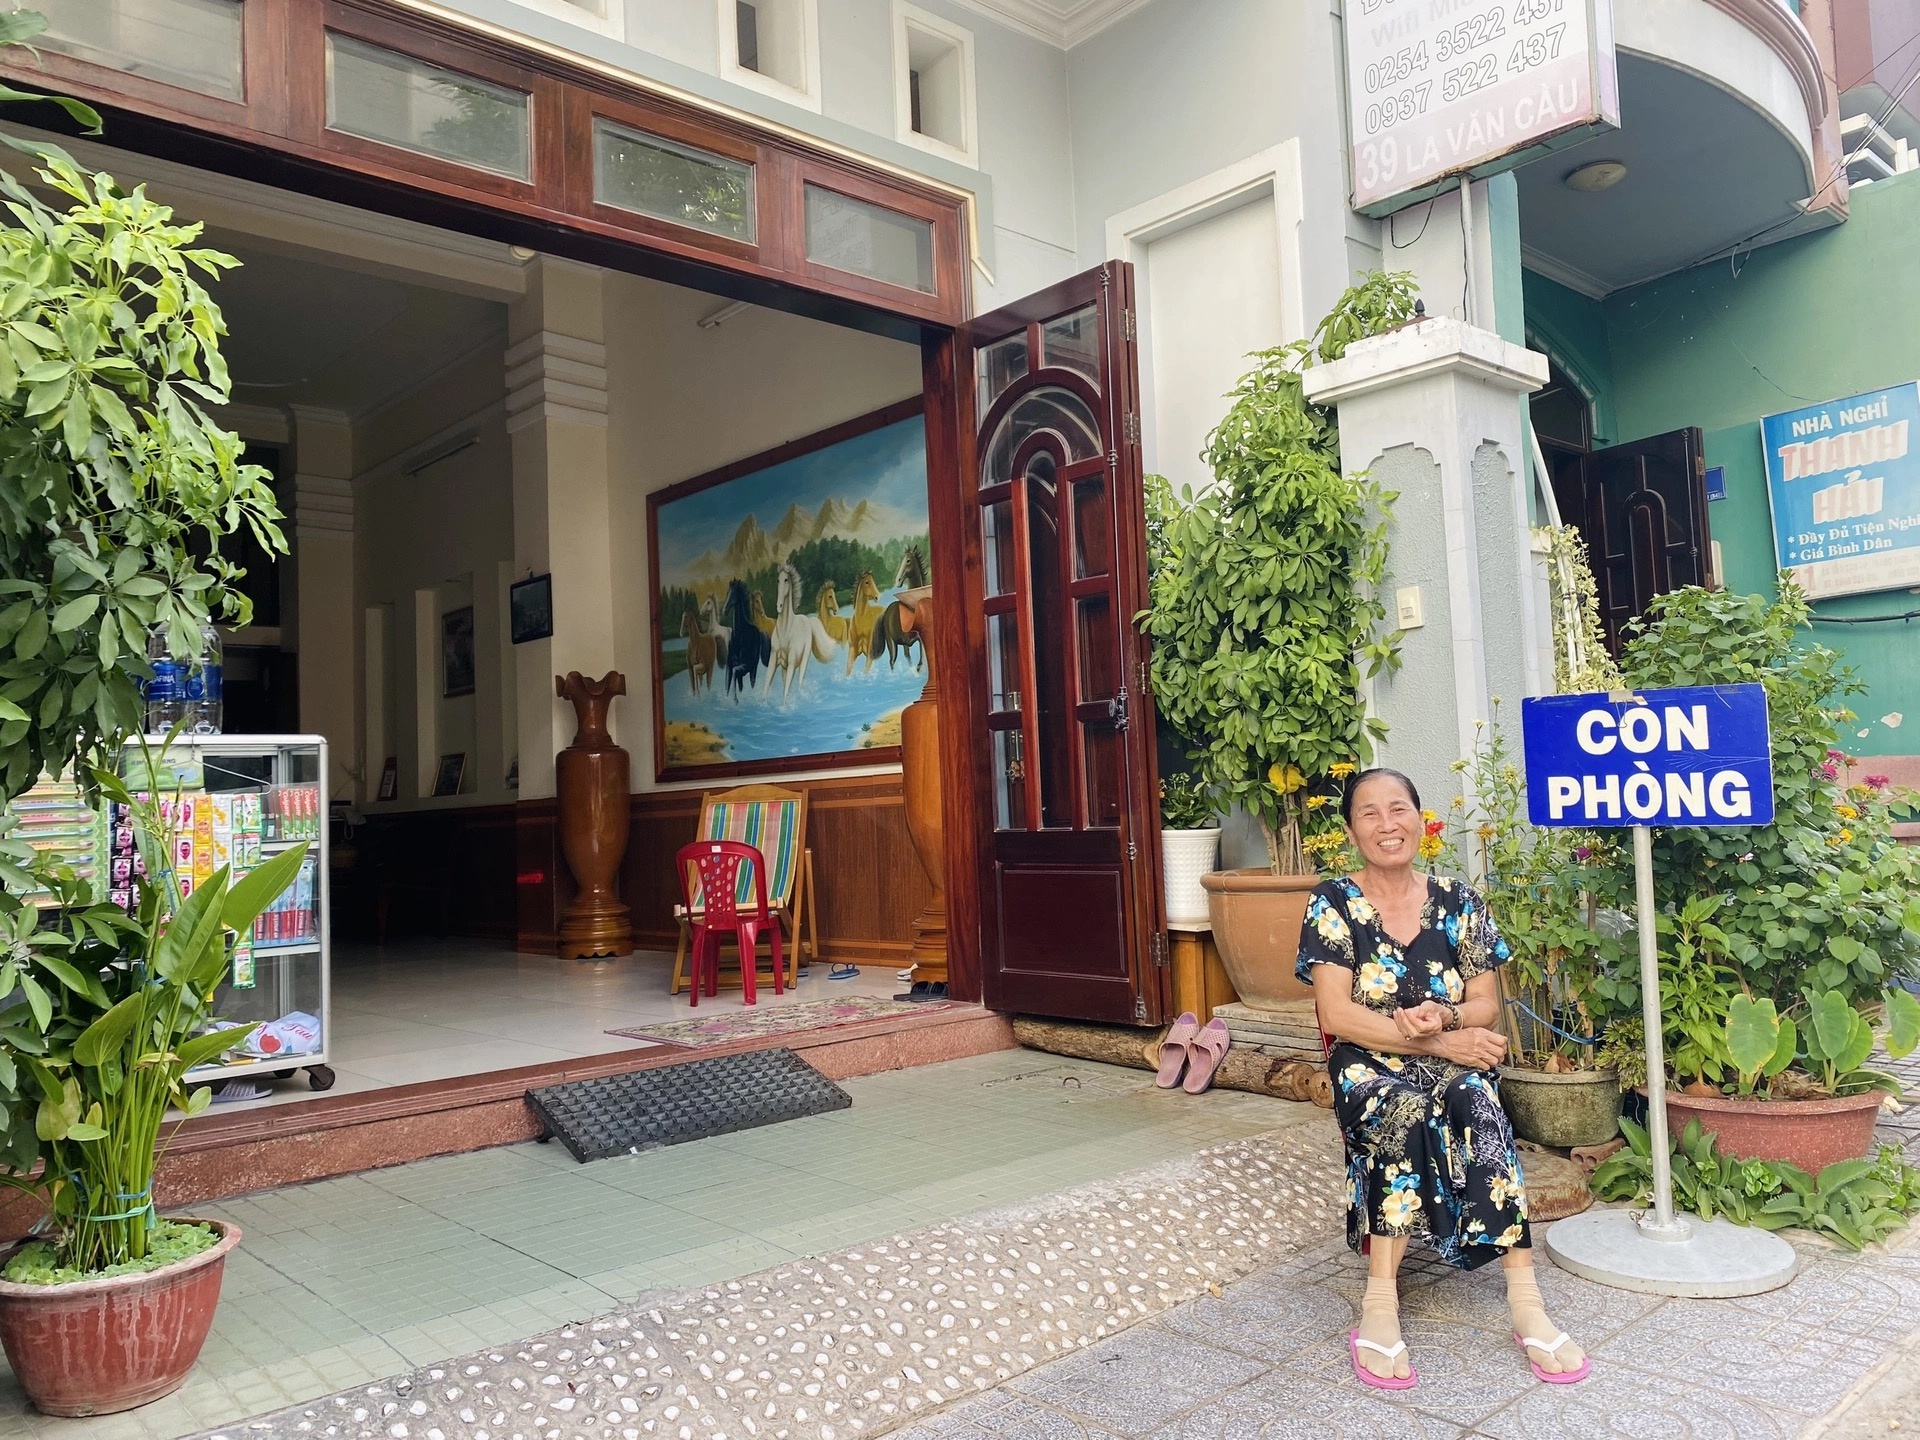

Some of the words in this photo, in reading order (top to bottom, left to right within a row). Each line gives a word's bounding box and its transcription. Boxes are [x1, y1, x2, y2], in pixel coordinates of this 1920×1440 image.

[1364, 40, 1429, 93] 0254
[1436, 6, 1506, 62] 3522
[1365, 79, 1432, 134] 0937
[1442, 54, 1498, 102] 522
[1507, 22, 1566, 74] 437
[1361, 136, 1398, 190] 39
[1406, 143, 1441, 174] LA
[1445, 107, 1505, 157] VĂN
[1778, 419, 1909, 482] THANH
[1792, 410, 1833, 438] NHÀ
[1813, 469, 1884, 524] HẢI
[1800, 546, 1824, 561] Giá
[1576, 696, 1709, 755] CÒN
[1547, 761, 1751, 819] PHÒNG
